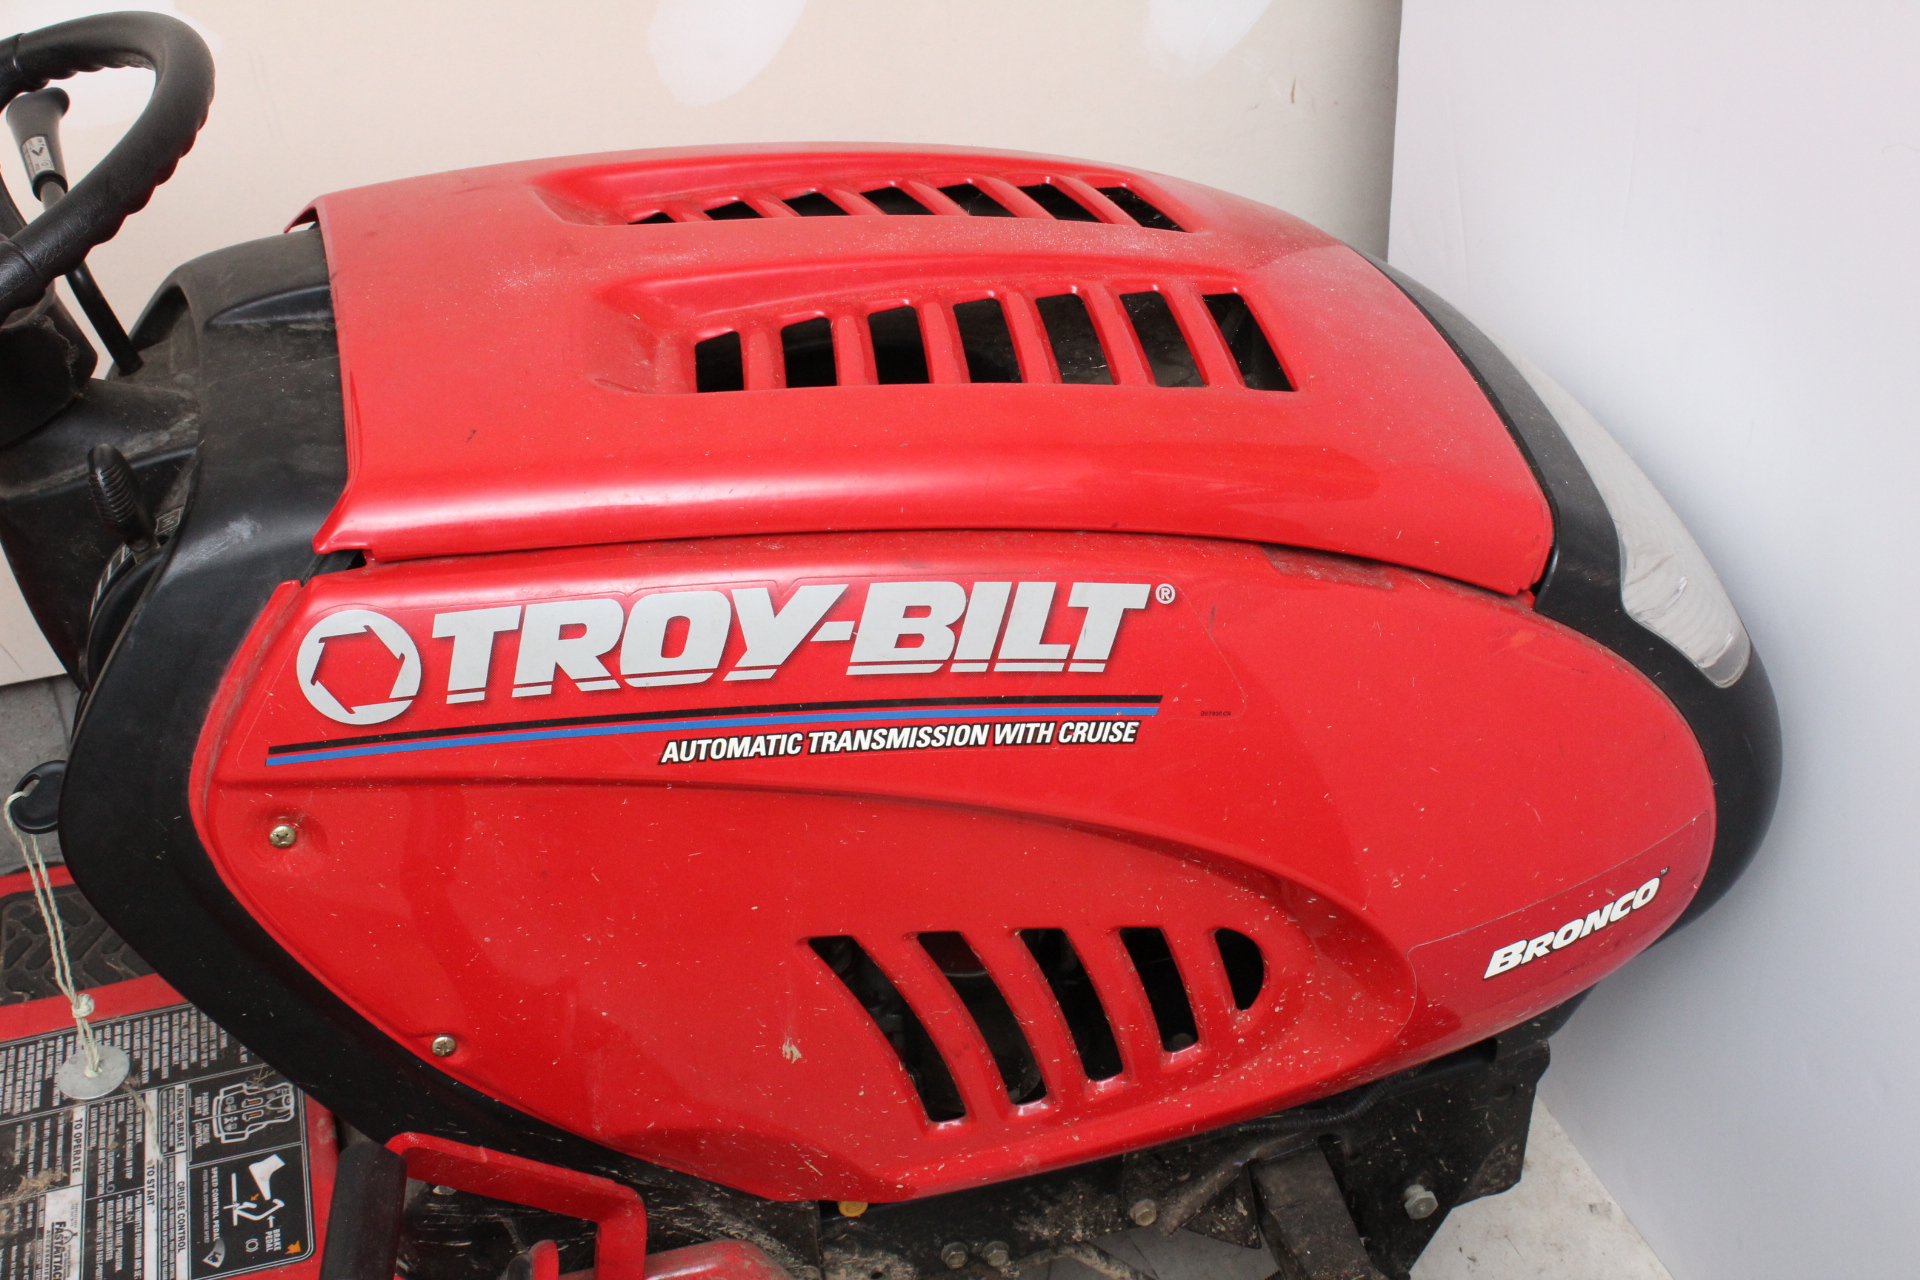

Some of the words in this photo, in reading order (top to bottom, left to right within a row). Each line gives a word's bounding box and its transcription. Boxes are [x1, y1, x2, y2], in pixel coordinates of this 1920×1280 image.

[432, 581, 1151, 704] TROY-BILT
[660, 733, 803, 763] AUTOMATIC
[808, 725, 987, 753] TRANSMISSION
[994, 722, 1054, 745] WITH
[1058, 721, 1140, 744] CRUISE
[1483, 877, 1660, 980] BRONCO
[74, 1118, 83, 1129] TO
[72, 1133, 82, 1173] OPERATE
[147, 1165, 155, 1176] TO
[211, 1167, 219, 1187] SPEED
[147, 1178, 155, 1206] START
[177, 1181, 185, 1211] CRUISE
[265, 1231, 273, 1252] PEDAL
[273, 1229, 281, 1251] BRAKE
